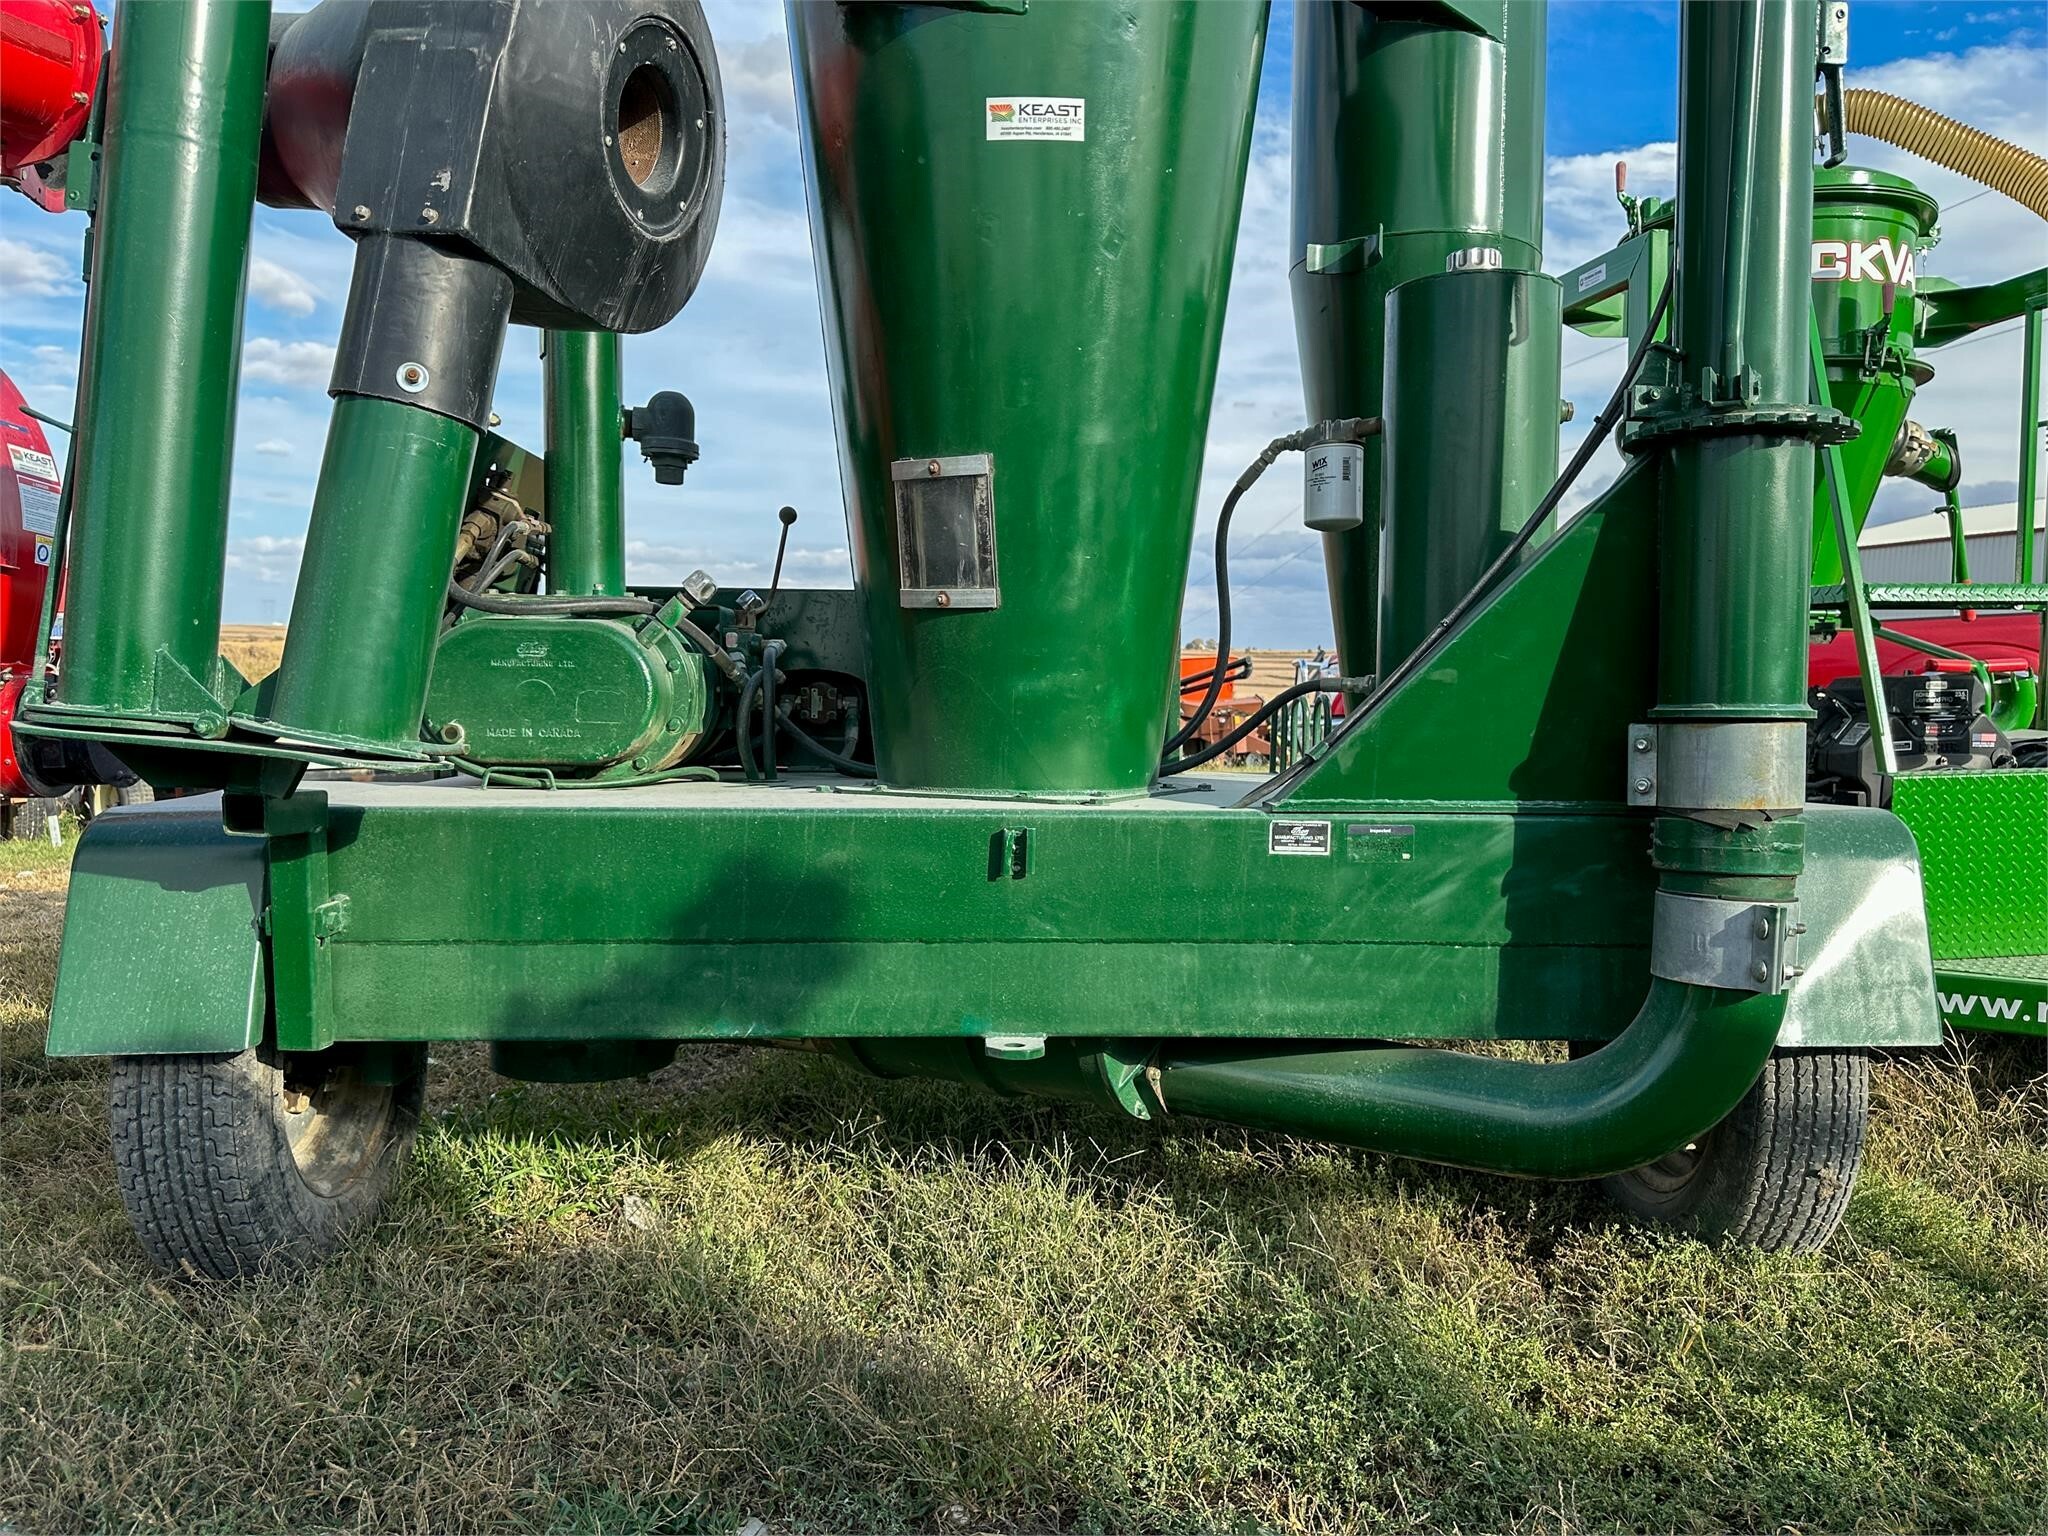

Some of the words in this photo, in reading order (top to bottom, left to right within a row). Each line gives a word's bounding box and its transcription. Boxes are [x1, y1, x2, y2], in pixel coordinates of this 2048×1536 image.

[1018, 104, 1083, 117] KEAST
[23, 451, 52, 466] KEAST
[1311, 456, 1328, 469] WIX
[490, 659, 554, 668] MANUFACTURING
[486, 728, 516, 738] MADE
[522, 728, 533, 737] IN
[538, 728, 582, 738] CANADA
